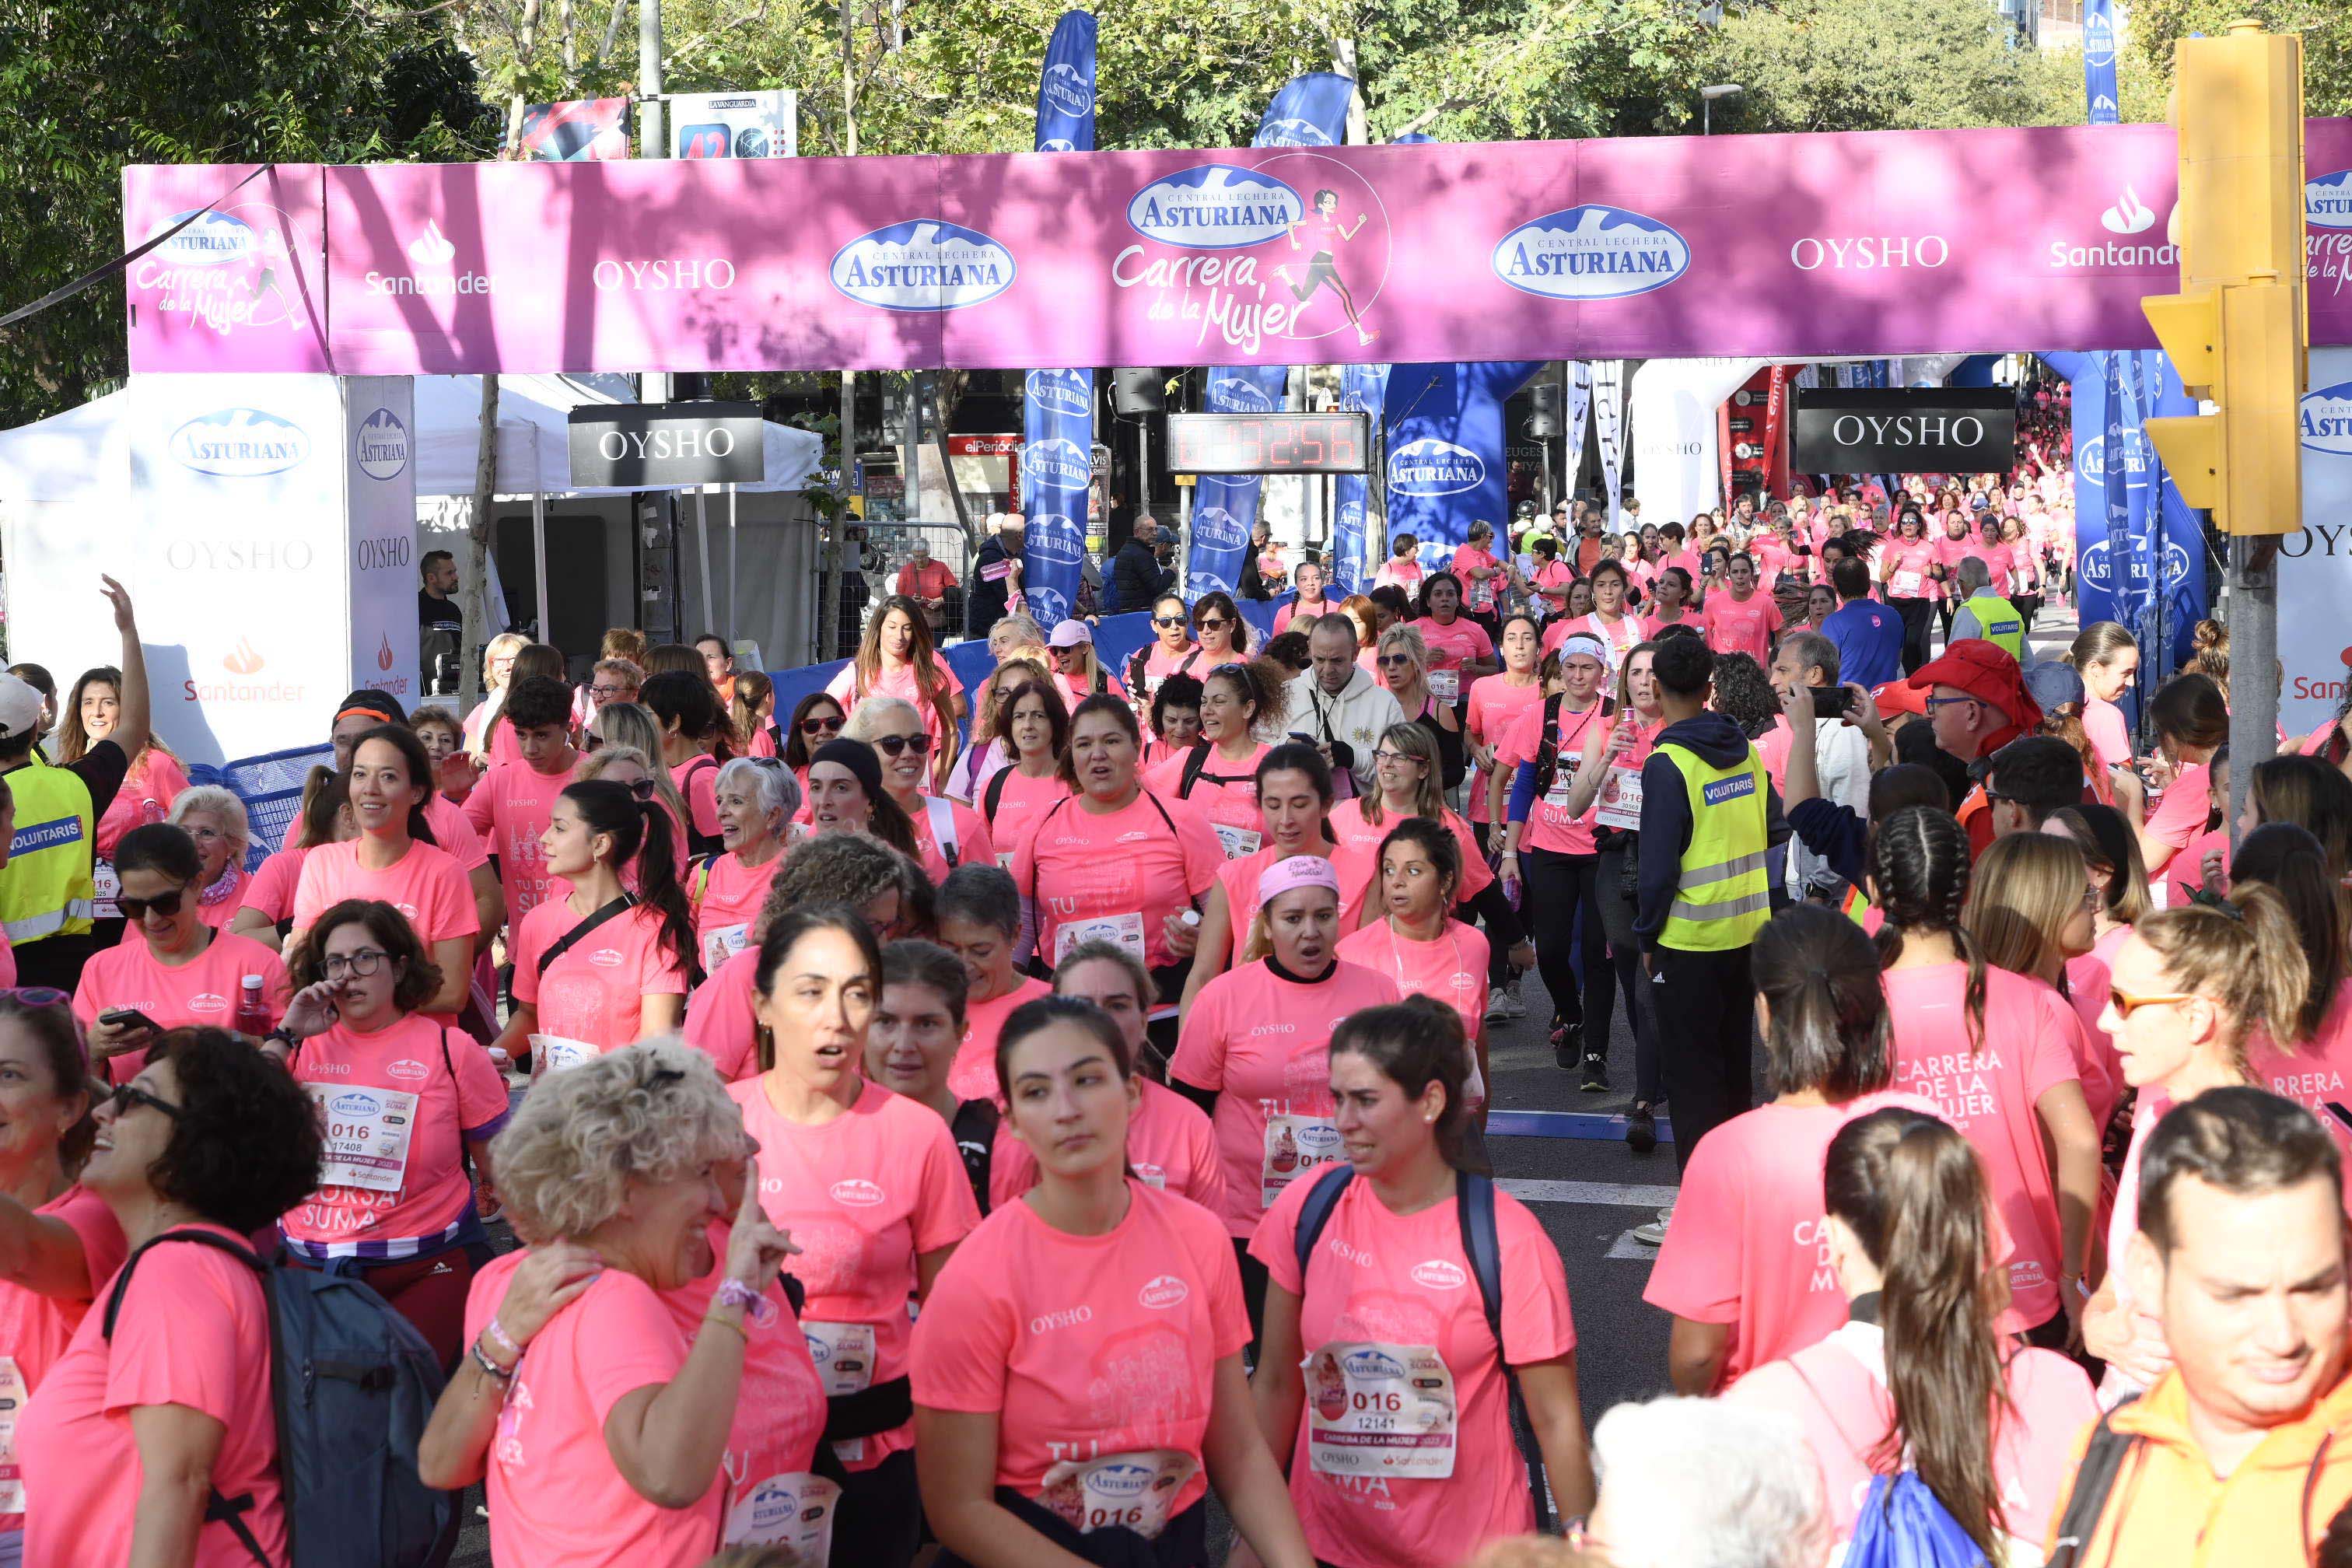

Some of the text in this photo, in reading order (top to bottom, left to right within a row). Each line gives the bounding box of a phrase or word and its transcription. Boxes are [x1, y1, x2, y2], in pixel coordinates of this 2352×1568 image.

[717, 100, 756, 108] VANGUARDIA
[1167, 192, 1285, 202] CENTRAL LECHERA
[1139, 195, 1290, 227] ASTURIANA
[1538, 236, 1669, 247] CENTRAL LECHERA
[873, 250, 996, 261] CENTRAL LECHERA
[1507, 242, 1675, 275] ASTURIANA
[1790, 236, 1949, 271] OYSHO
[2049, 241, 2181, 268] Santand
[136, 261, 231, 290] Carrera
[593, 259, 736, 292] OYSHO
[845, 254, 1003, 288] ASTURIANA
[1112, 245, 1258, 288] Carrera
[2323, 257, 2336, 278] la
[365, 271, 498, 296] Santander
[159, 289, 262, 335] de la Mujer
[1149, 282, 1313, 355] de la Mujer
[1032, 376, 1089, 411] ASTURIANA
[1833, 415, 1984, 447] OYSHO
[185, 434, 300, 460] ASTURIANA
[360, 440, 405, 463] ASTURIANA
[599, 428, 735, 460] OYSHO
[1028, 450, 1087, 483] ASTURIANA
[1389, 465, 1479, 484] ASTURIANA
[166, 539, 313, 572] OYSHO
[358, 536, 410, 571] OYSHO
[1721, 638, 1731, 646] TU
[184, 680, 306, 702] Santander
[1621, 793, 1642, 803] 016
[1705, 777, 1753, 800] VOLUNTARIS
[1055, 837, 1090, 846] OYSHO
[1351, 835, 1381, 844] OYSHO
[515, 879, 530, 891] TU
[1049, 896, 1076, 915] TU
[191, 999, 226, 1009] ASTURIANA
[1251, 1024, 1295, 1036] OYSHO
[309, 1062, 350, 1075] OYSHO
[1897, 1050, 2004, 1083] CARRERA
[1916, 1073, 1988, 1099] DE LA
[334, 1101, 376, 1112] ASTURIANA
[1259, 1098, 1290, 1118] TU
[332, 1123, 370, 1139] 016
[1302, 1132, 1338, 1143] ASTURIANA
[332, 1142, 362, 1153] 17408
[358, 1171, 394, 1183] Santander
[301, 1204, 376, 1231] SUMA
[1031, 1305, 1092, 1335] OYSHO
[1348, 1363, 1401, 1376] ASTURIANA
[1353, 1392, 1402, 1412] 016
[1358, 1417, 1395, 1430] 12141
[1324, 1434, 1357, 1443] CARRERA
[1360, 1436, 1373, 1444] DE
[1373, 1436, 1384, 1444] LA
[1387, 1437, 1418, 1445] MUJER
[1322, 1452, 1444, 1465] OYSHO Santander
[1090, 1507, 1143, 1528] 016
